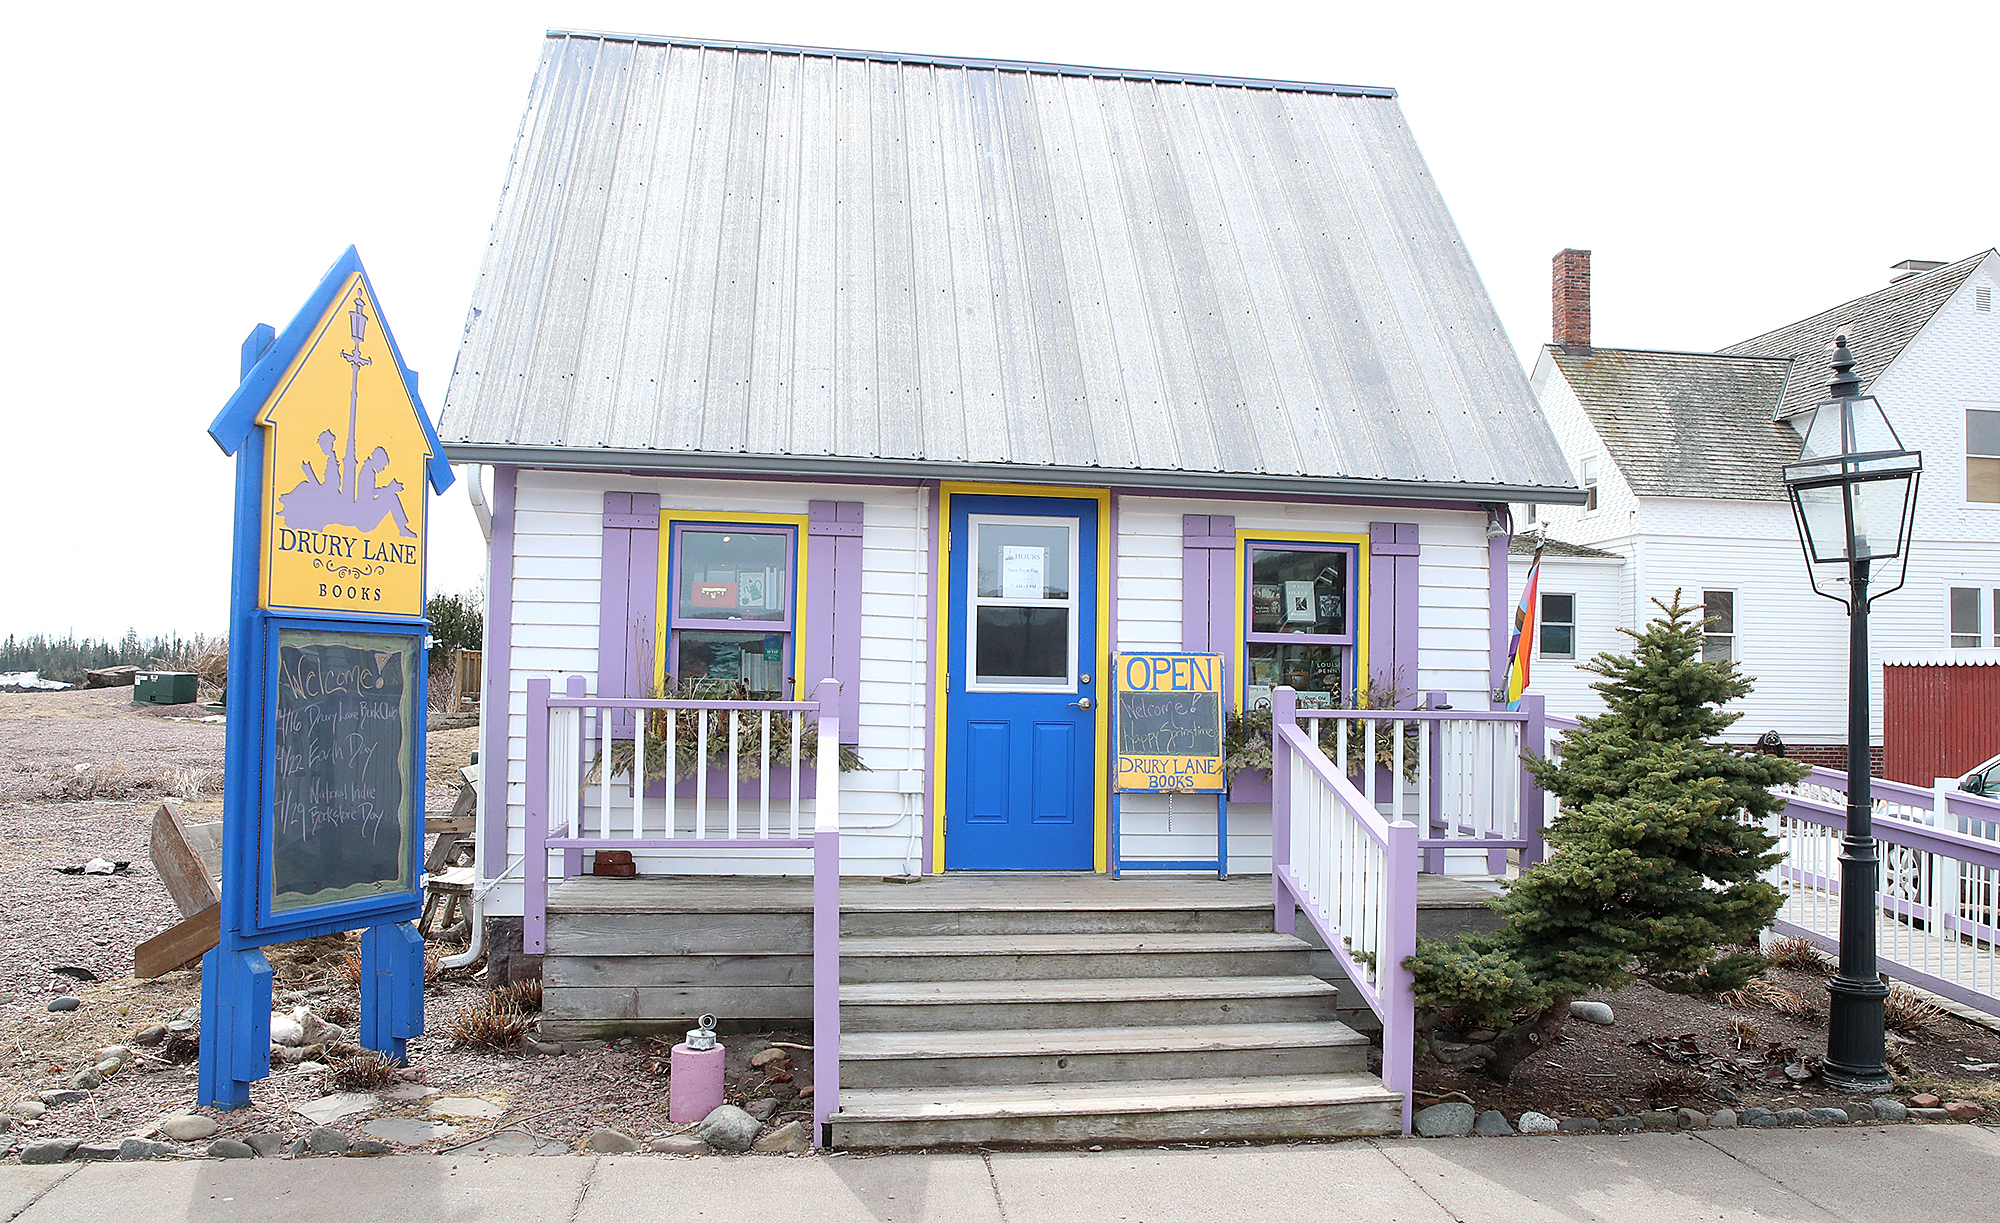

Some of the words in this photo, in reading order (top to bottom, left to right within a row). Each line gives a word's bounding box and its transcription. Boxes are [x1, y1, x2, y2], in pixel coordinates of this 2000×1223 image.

[278, 528, 357, 558] DRURY
[362, 539, 417, 565] LANE
[1014, 553, 1041, 561] HOURS
[319, 583, 381, 601] BOOKS
[282, 653, 392, 699] Welcome!
[1126, 656, 1213, 691] OPEN
[279, 707, 302, 744] 4/16
[304, 704, 337, 738] Drury
[339, 701, 359, 722] Lane
[1122, 720, 1161, 752] Happy
[275, 744, 304, 780] 4/22
[308, 738, 344, 768] Earth
[345, 732, 378, 782] Day
[1119, 757, 1170, 774] DRURY
[1173, 758, 1217, 775] LANE
[1149, 775, 1194, 788] BOOKS
[274, 788, 307, 842] 4/29
[309, 777, 347, 804] National
[351, 783, 376, 802] Indie
[308, 805, 357, 835] Bookstore
[358, 802, 385, 845] Day
